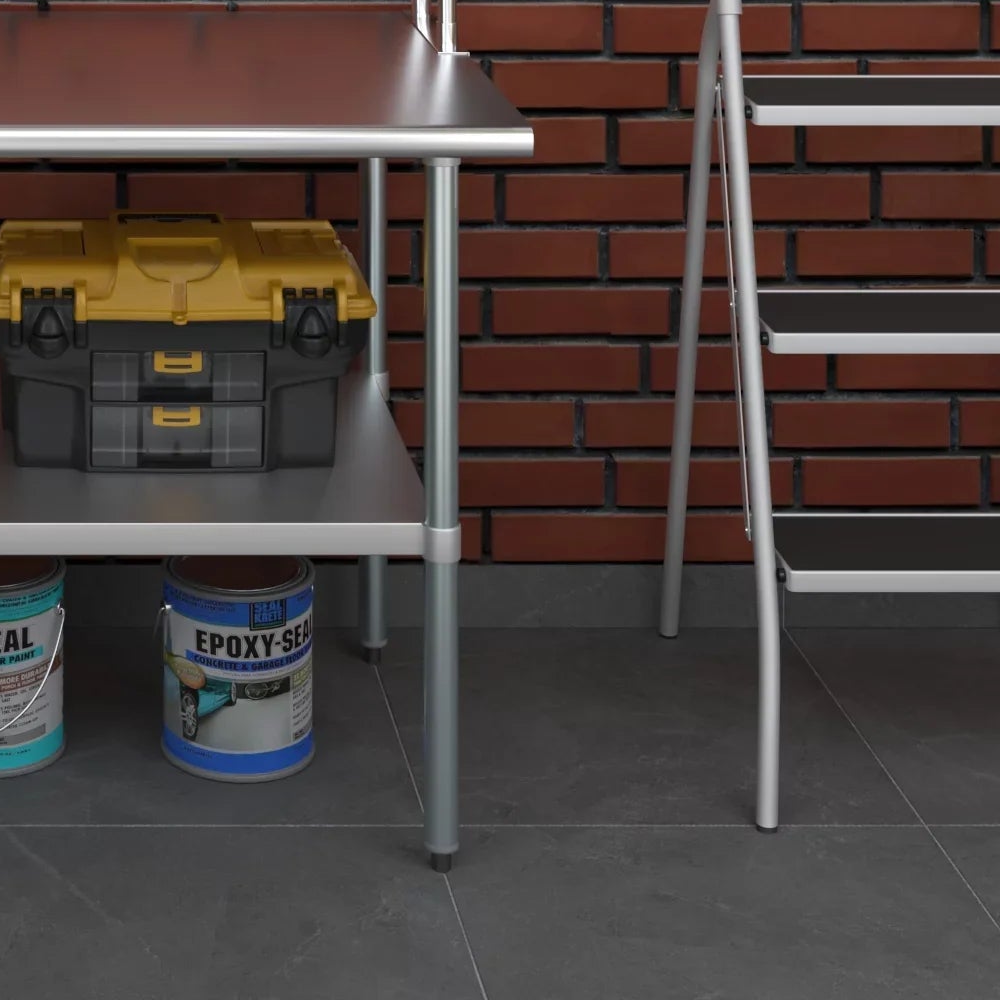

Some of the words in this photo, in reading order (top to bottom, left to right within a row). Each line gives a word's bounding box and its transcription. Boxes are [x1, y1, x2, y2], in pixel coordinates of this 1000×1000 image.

[253, 600, 282, 613] SEAL
[254, 612, 283, 624] KRETE
[9, 650, 36, 664] PAINT
[194, 654, 237, 671] CONCRETE
[252, 660, 284, 670] GARAGE
[0, 676, 20, 685] MORE
